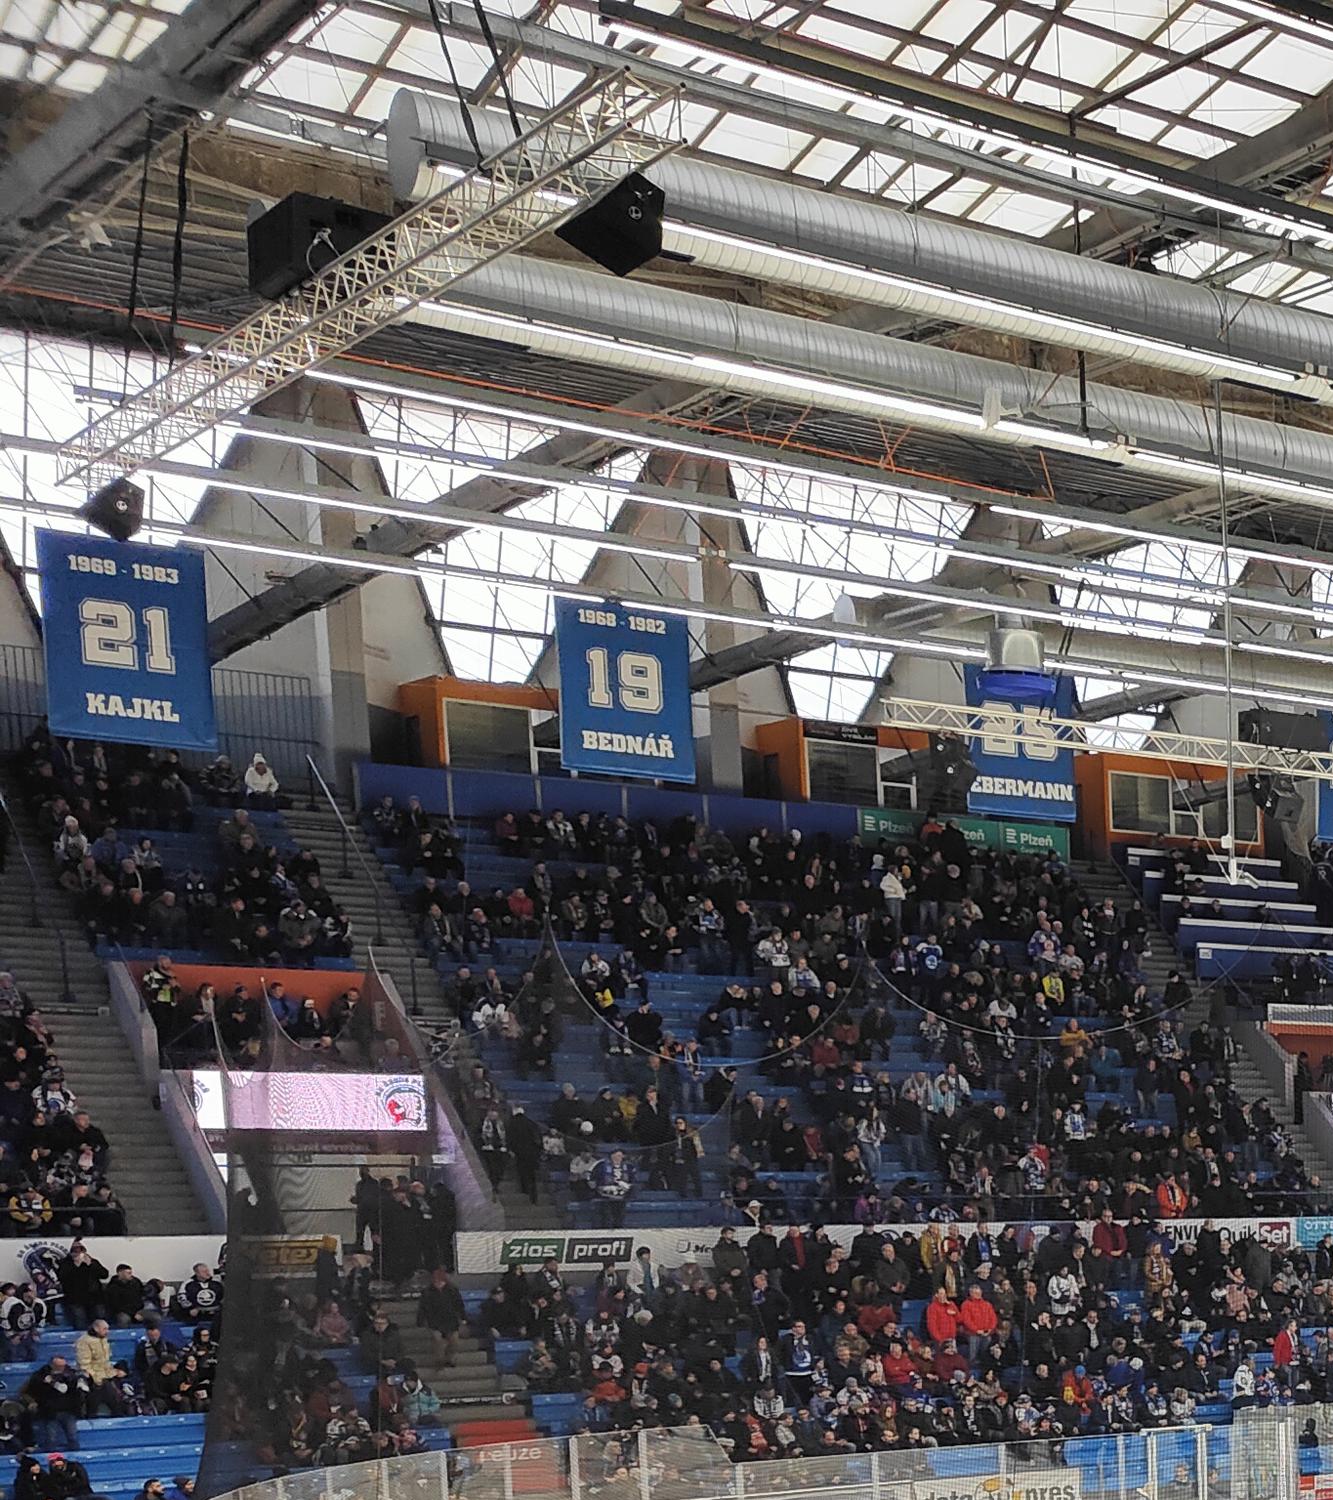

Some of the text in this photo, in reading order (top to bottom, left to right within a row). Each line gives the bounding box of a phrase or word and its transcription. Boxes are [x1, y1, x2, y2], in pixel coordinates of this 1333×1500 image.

[68, 554, 116, 576] 1969
[132, 563, 179, 584] 1983
[78, 597, 177, 675] 21
[577, 608, 617, 628] 1968
[628, 615, 666, 635] 1982
[586, 647, 664, 714] 19
[85, 692, 180, 722] KAJKL
[581, 730, 675, 758] BEDNÁŘ
[1020, 832, 1053, 848] Plzeň
[573, 1240, 627, 1261] profi
